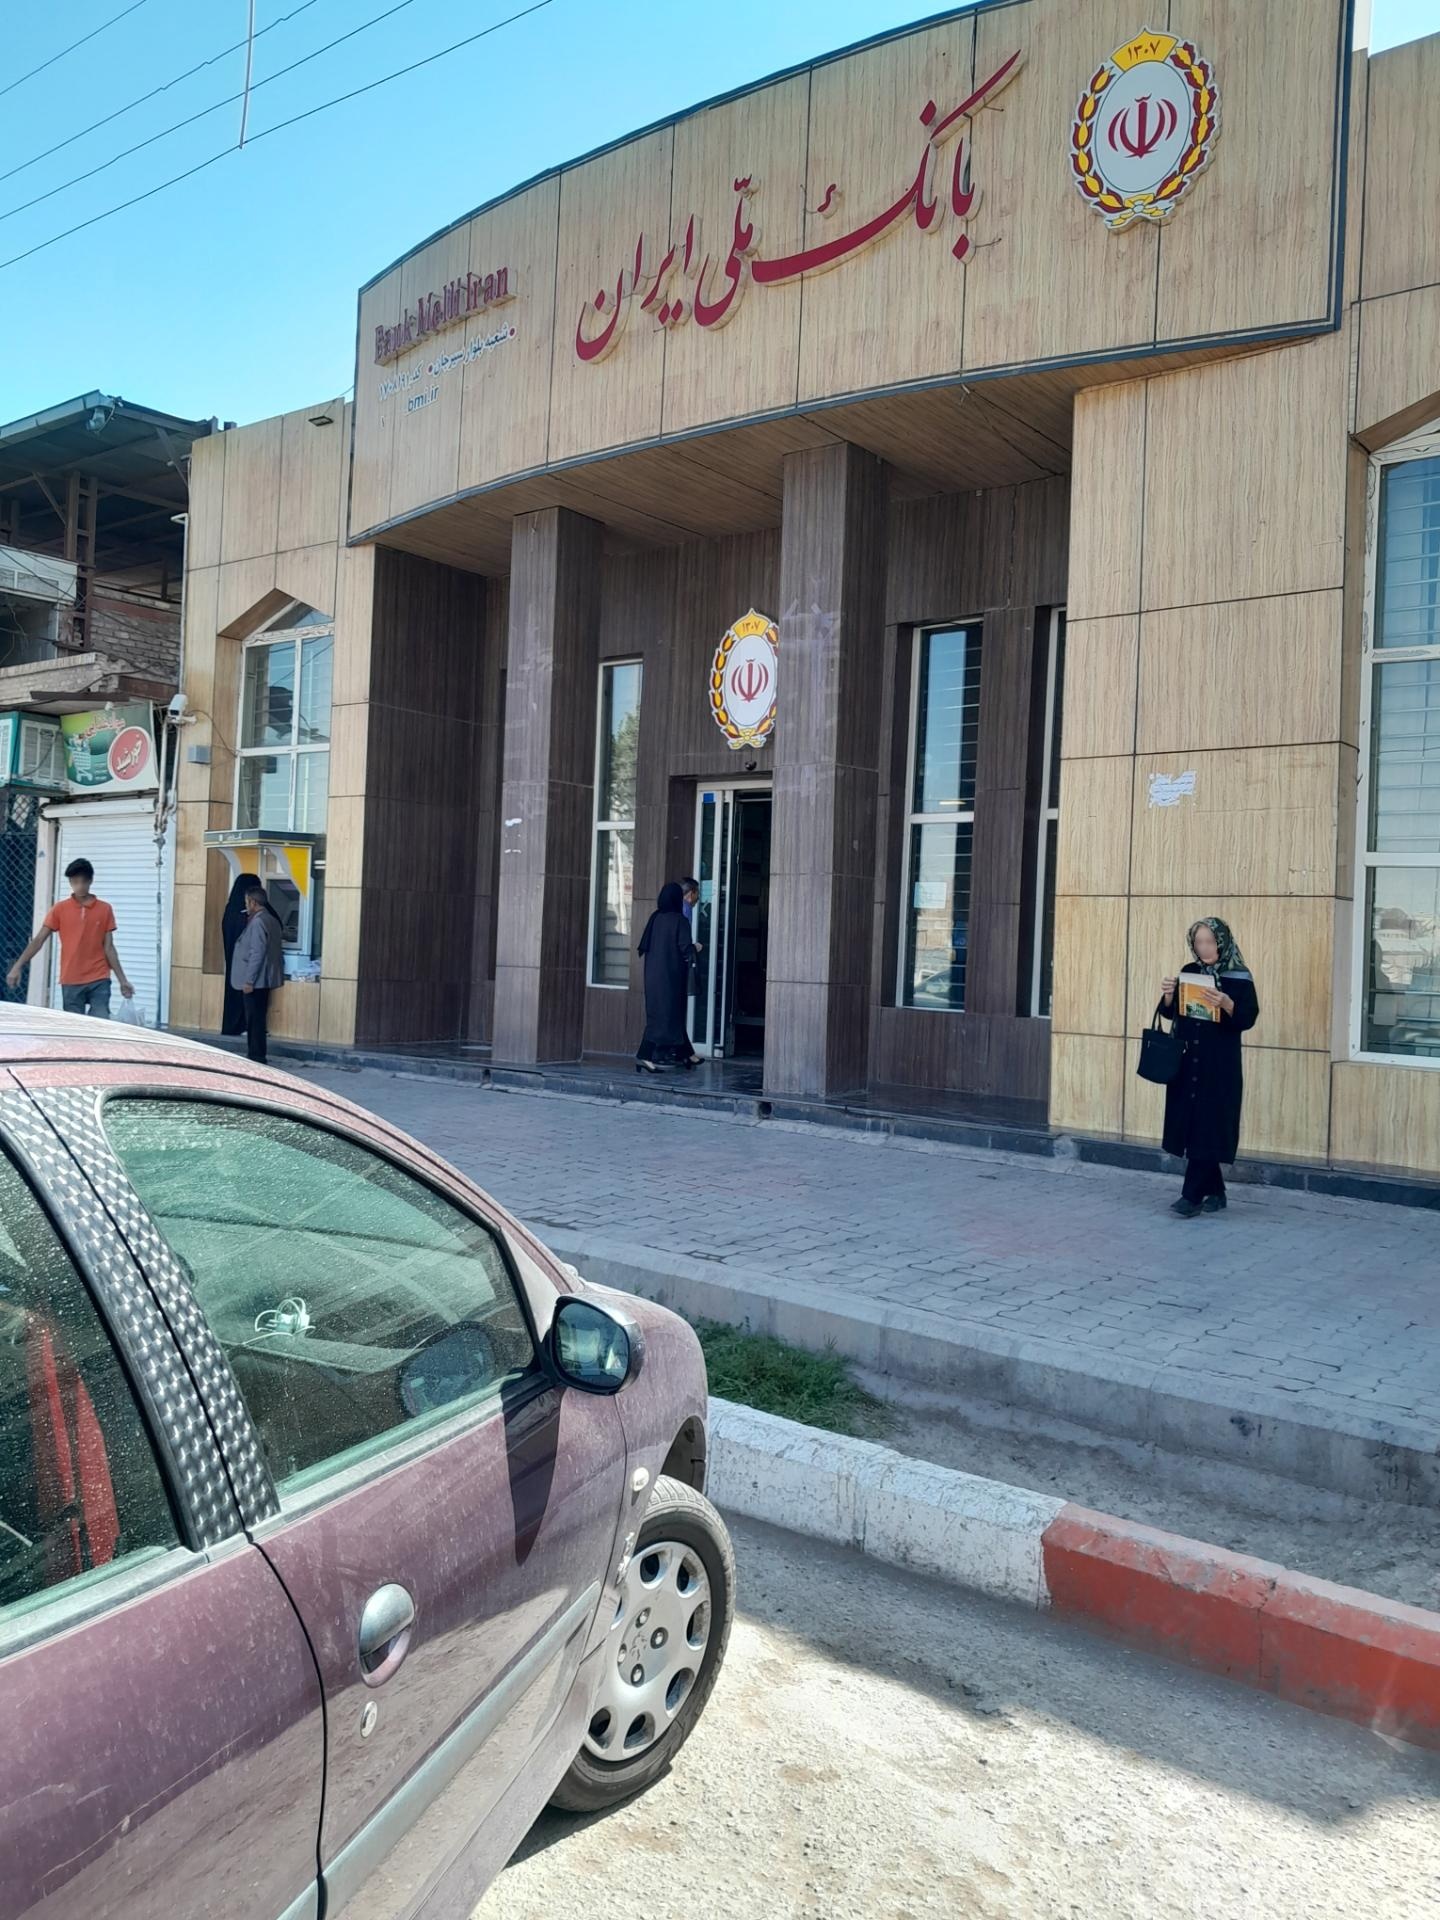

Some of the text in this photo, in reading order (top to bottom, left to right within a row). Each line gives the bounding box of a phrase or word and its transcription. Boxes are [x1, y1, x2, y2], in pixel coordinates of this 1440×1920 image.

[1126, 39, 1161, 62] ۱۳۰۷
[575, 213, 695, 362] ایران
[374, 266, 510, 362] Bank Melli Iran
[484, 322, 509, 349] شعبه
[407, 385, 440, 412] bmi.ir
